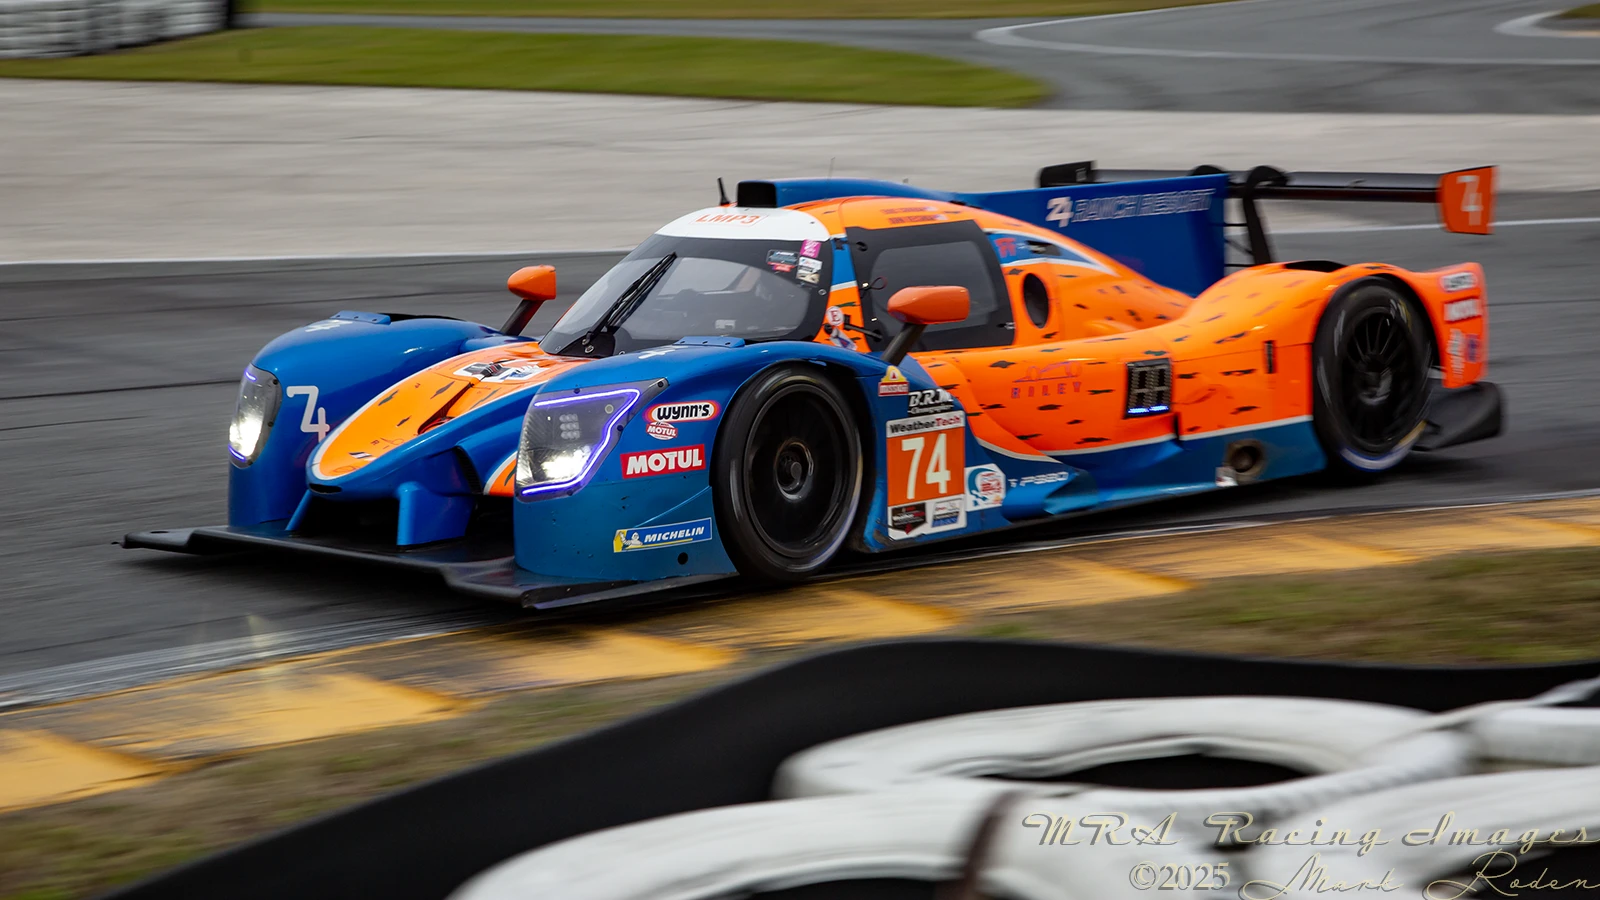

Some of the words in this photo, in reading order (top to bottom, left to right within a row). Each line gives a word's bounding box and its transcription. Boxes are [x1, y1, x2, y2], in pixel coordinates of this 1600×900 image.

[1455, 175, 1484, 226] 74
[695, 213, 761, 225] LMP3
[830, 310, 841, 323] E
[1011, 381, 1082, 399] RILEY
[286, 385, 330, 443] 74
[647, 425, 677, 437] MOTUL
[889, 415, 961, 434] WeatherTech
[626, 449, 703, 475] MOTUL
[901, 433, 951, 500] 74
[644, 526, 705, 543] MICHELIN
